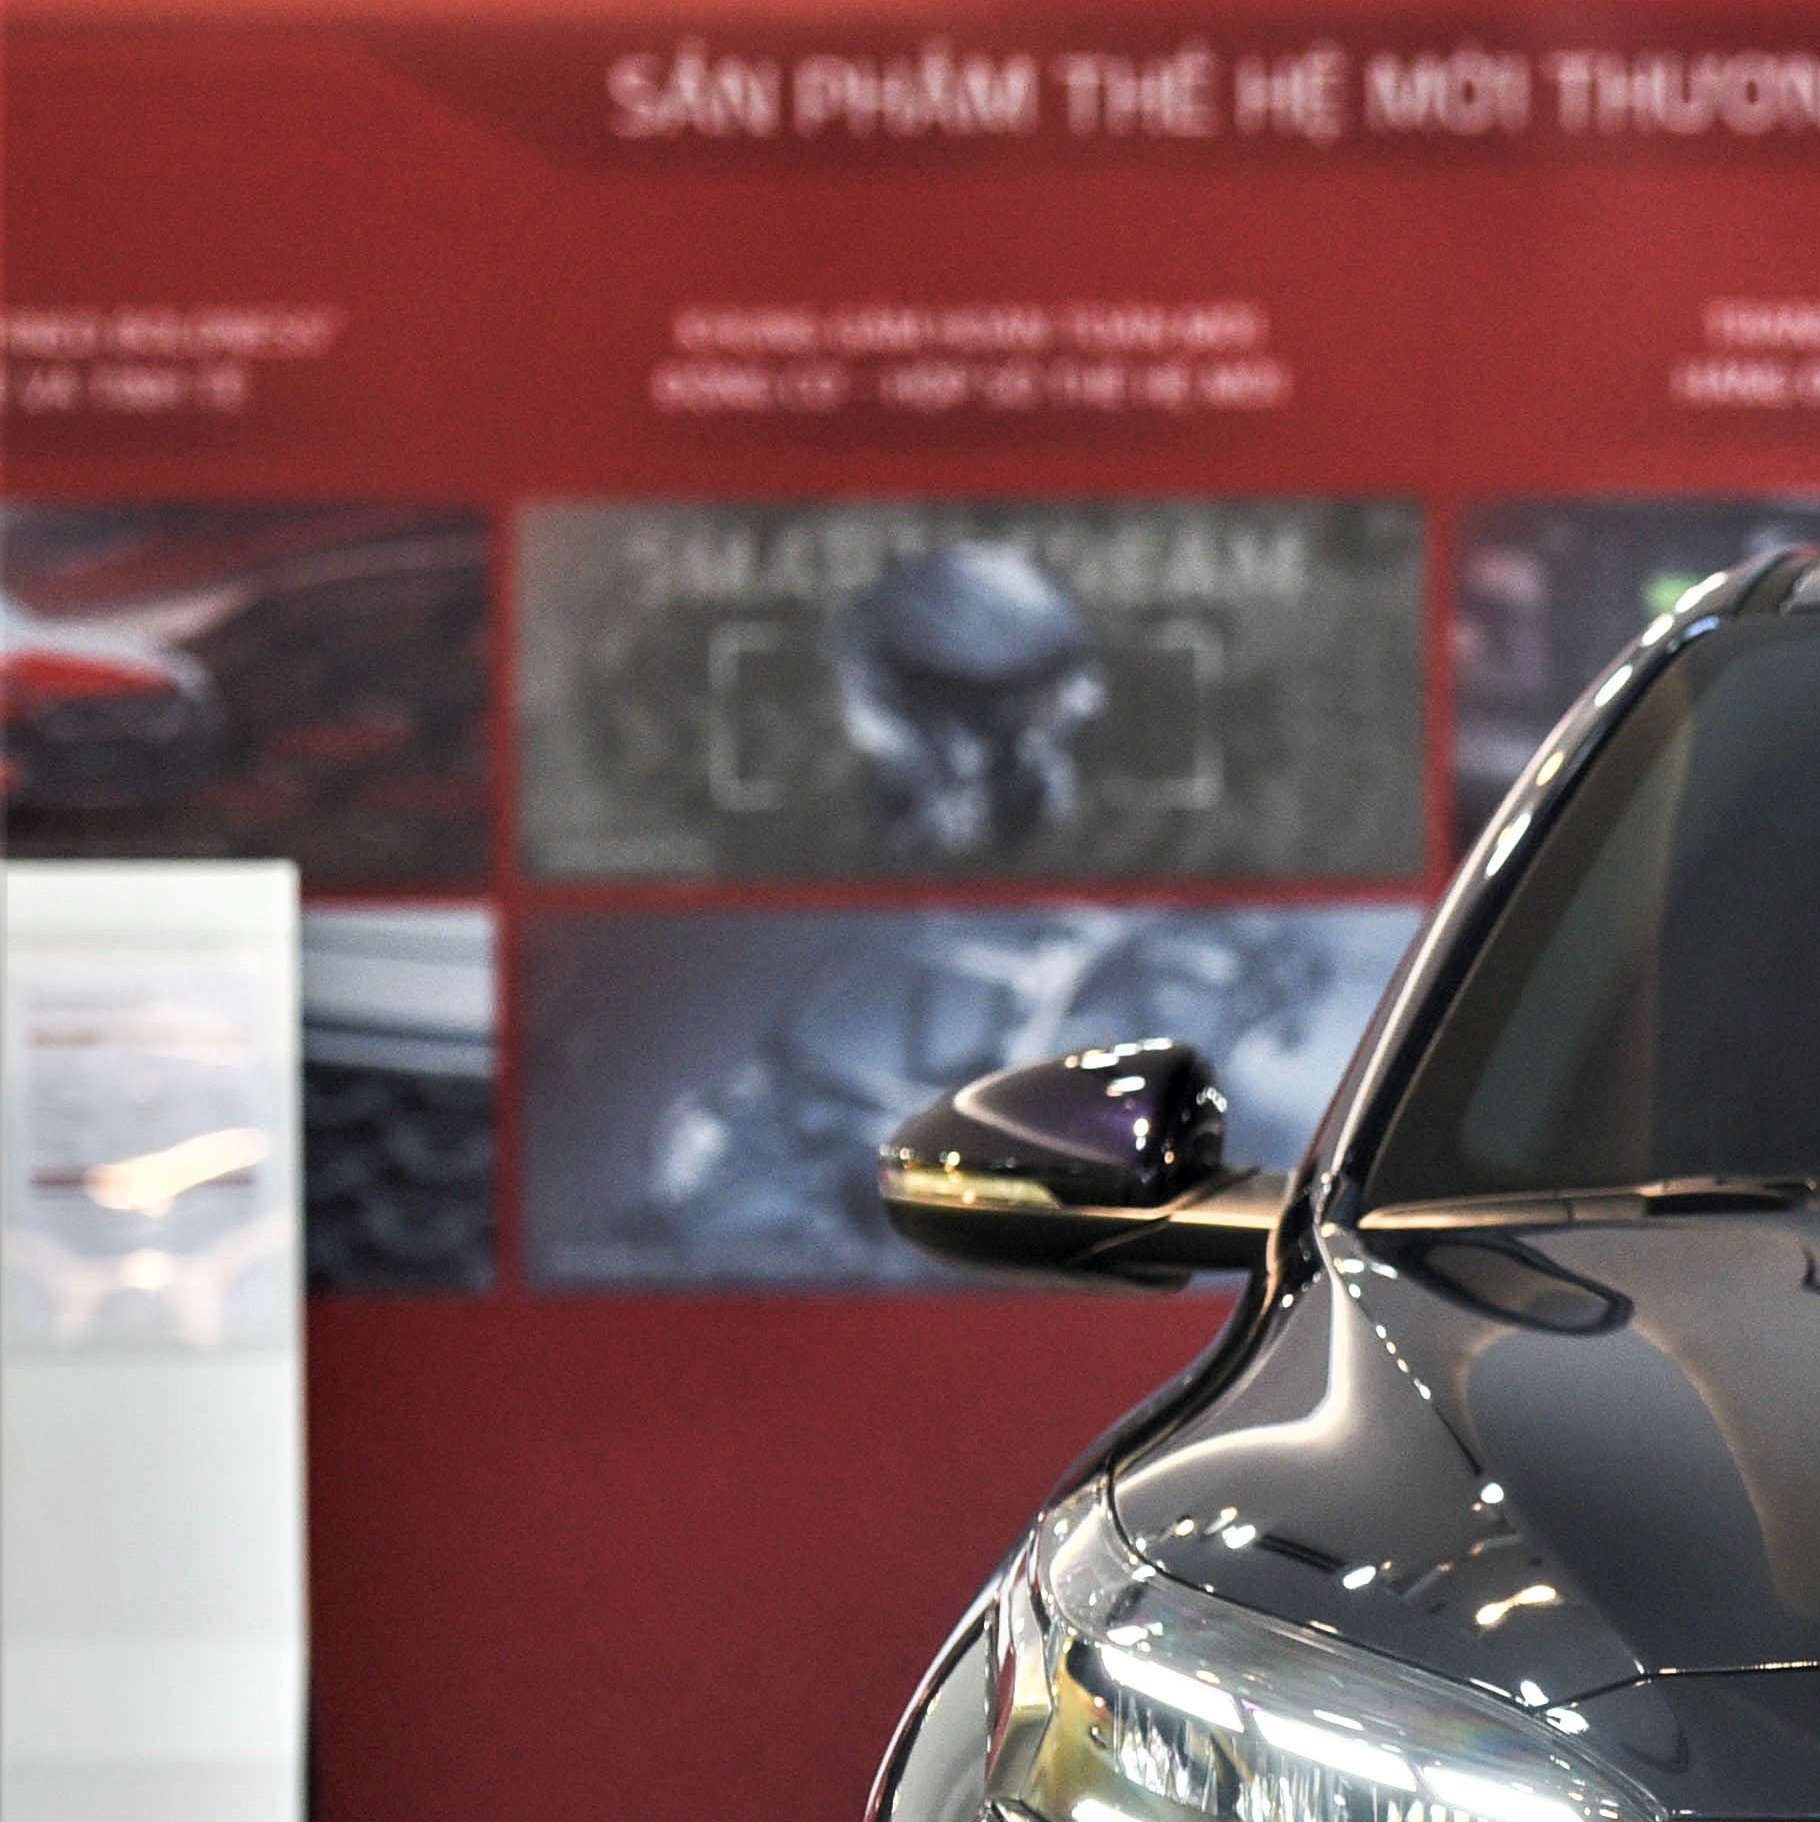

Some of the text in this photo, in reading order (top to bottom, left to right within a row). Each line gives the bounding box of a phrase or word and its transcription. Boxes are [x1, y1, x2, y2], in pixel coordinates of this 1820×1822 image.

[610, 42, 778, 132] SẢN
[1056, 43, 1217, 131] THẾ
[1238, 44, 1344, 142] HỆ
